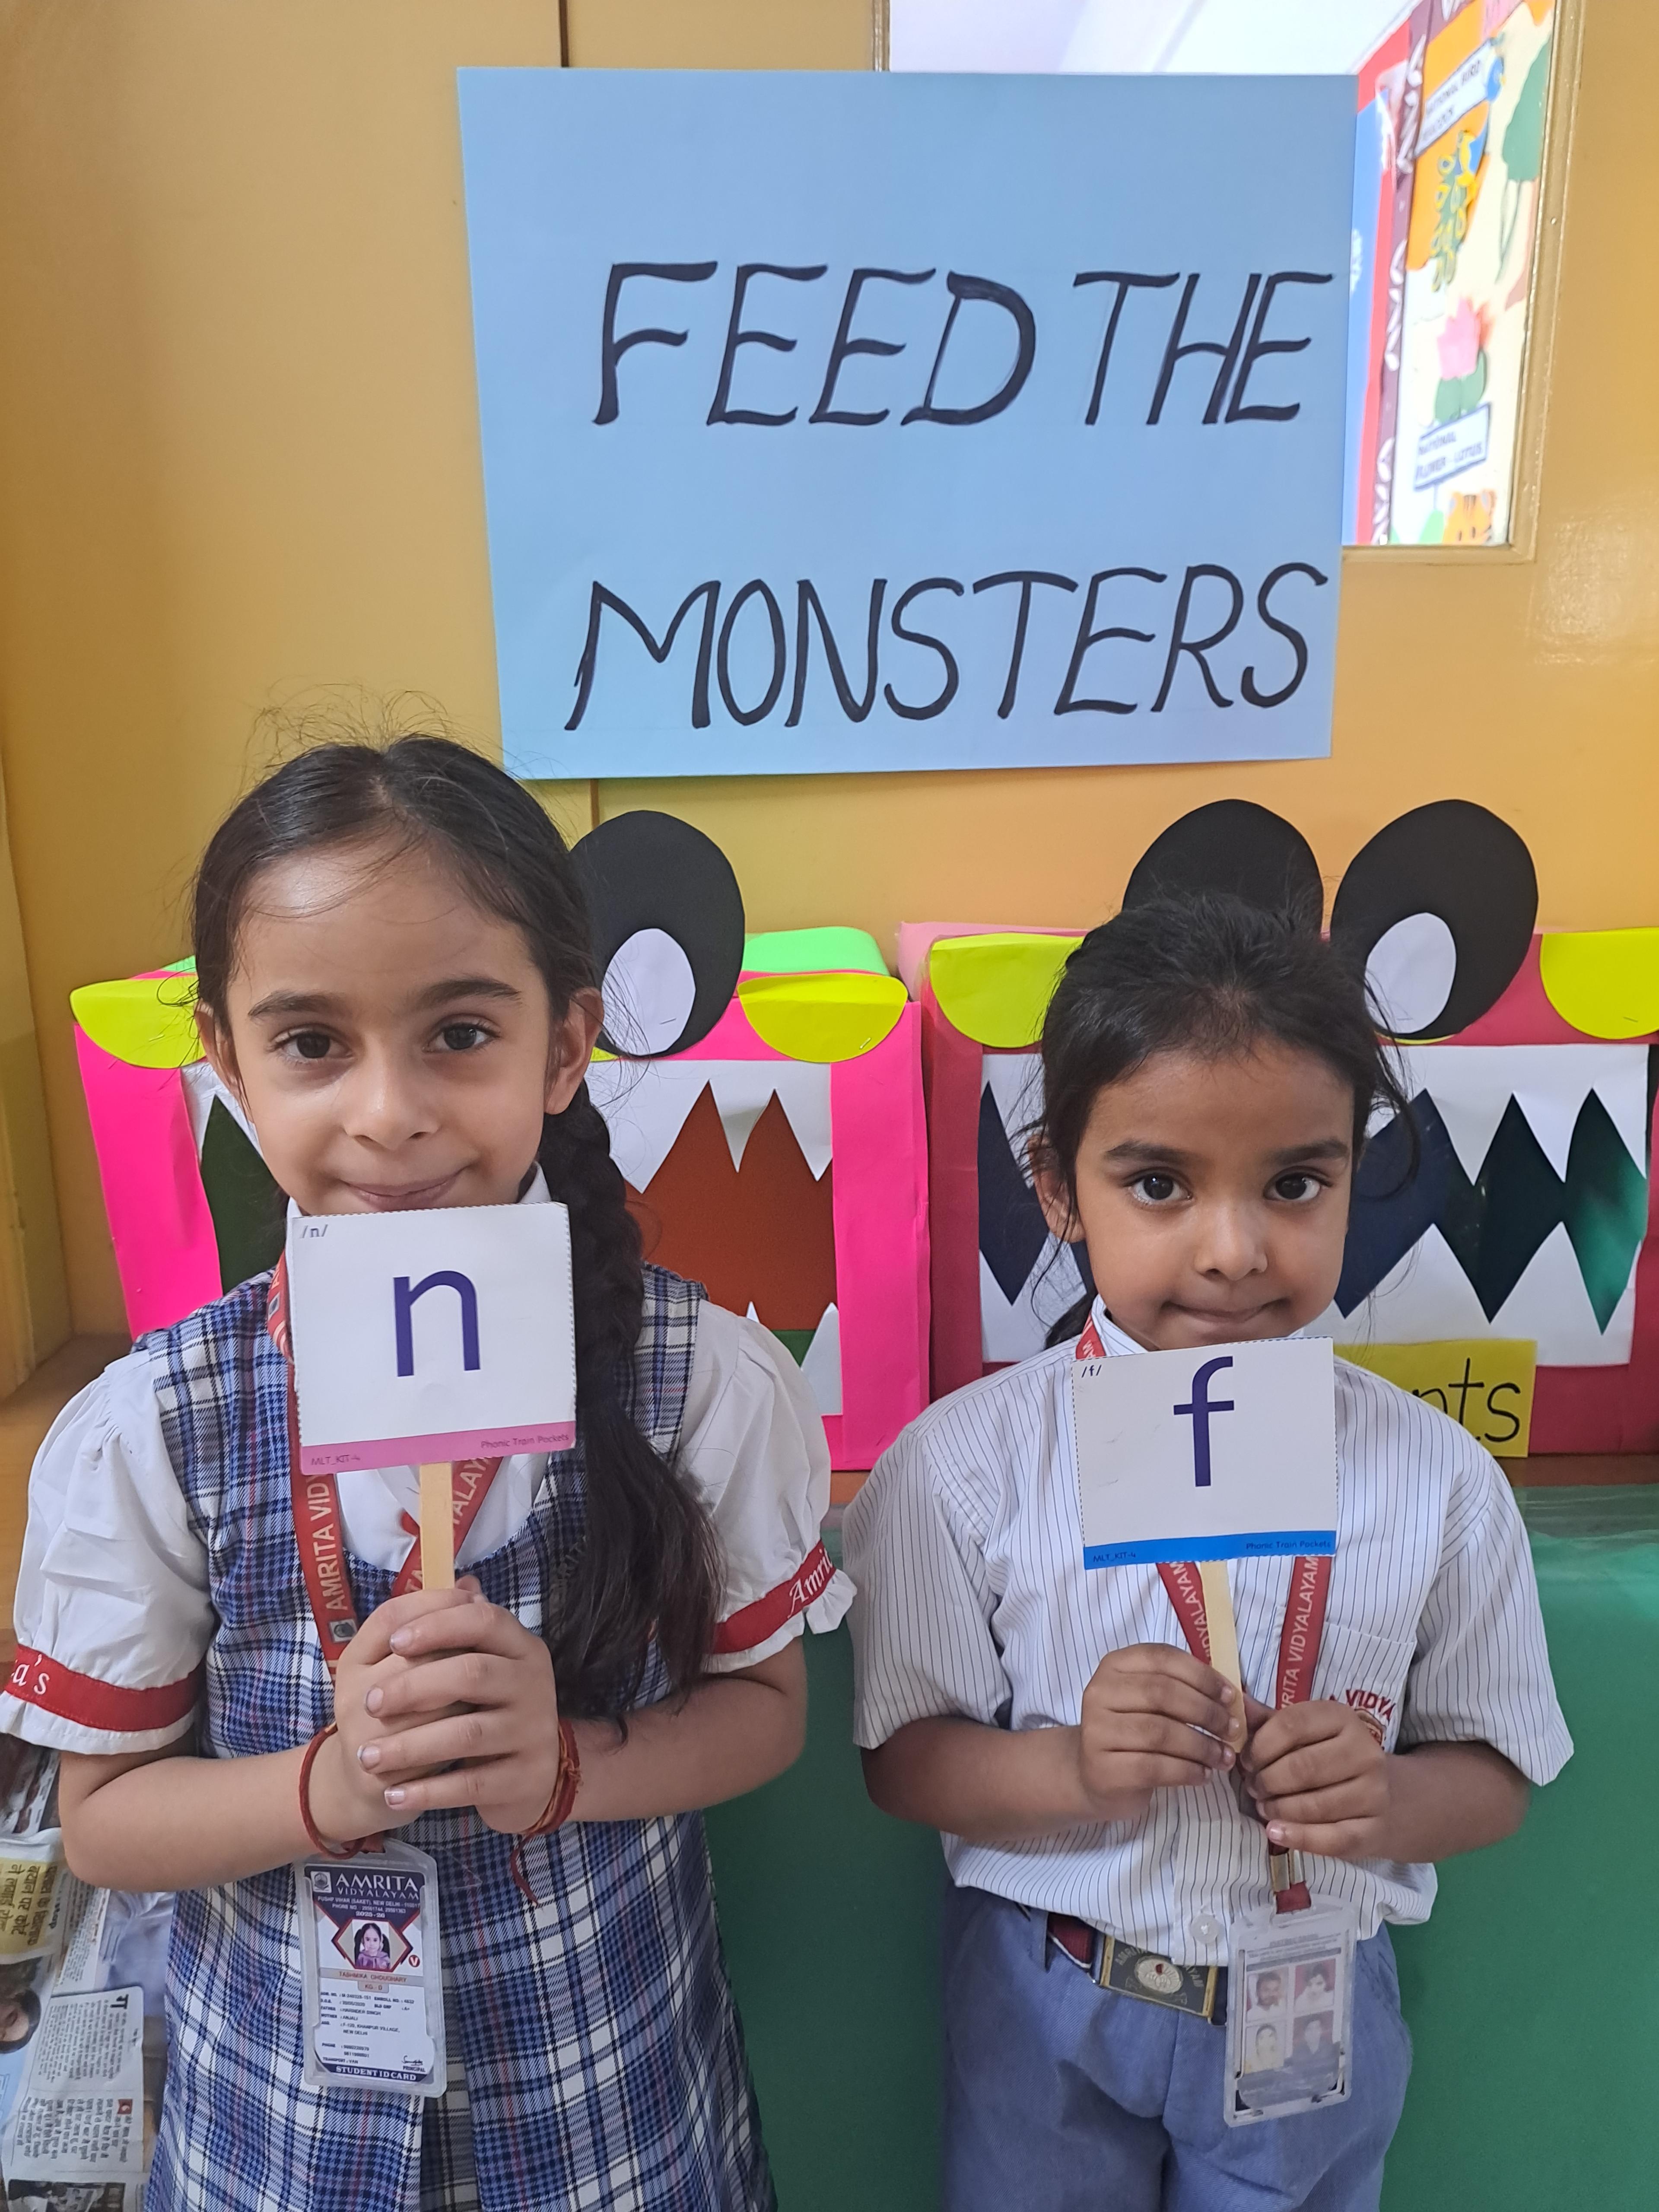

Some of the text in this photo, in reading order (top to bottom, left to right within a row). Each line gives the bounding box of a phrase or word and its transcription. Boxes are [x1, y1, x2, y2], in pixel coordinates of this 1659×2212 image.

[593, 261, 1334, 426] FEED THE
[564, 563, 1328, 731] MONSTERS
[300, 1224, 328, 1239] /n/
[393, 1270, 481, 1377] n
[1081, 1364, 1102, 1378] /f/
[1173, 1355, 1235, 1487] f
[481, 1433, 569, 1449] Phonic Train Pockets
[1246, 1541, 1273, 1550] Phonic
[1300, 1539, 1332, 1548] Pockets
[312, 1523, 348, 1611] AMRITA
[1281, 1556, 1319, 1709] RITA VIDYALAYAM
[11, 1653, 50, 1695] a's
[336, 1872, 418, 1892] AMRITA
[337, 1887, 419, 1900] VIDYALAYAM
[336, 2065, 378, 2077] STUDENT
[390, 2072, 417, 2081] CARD
